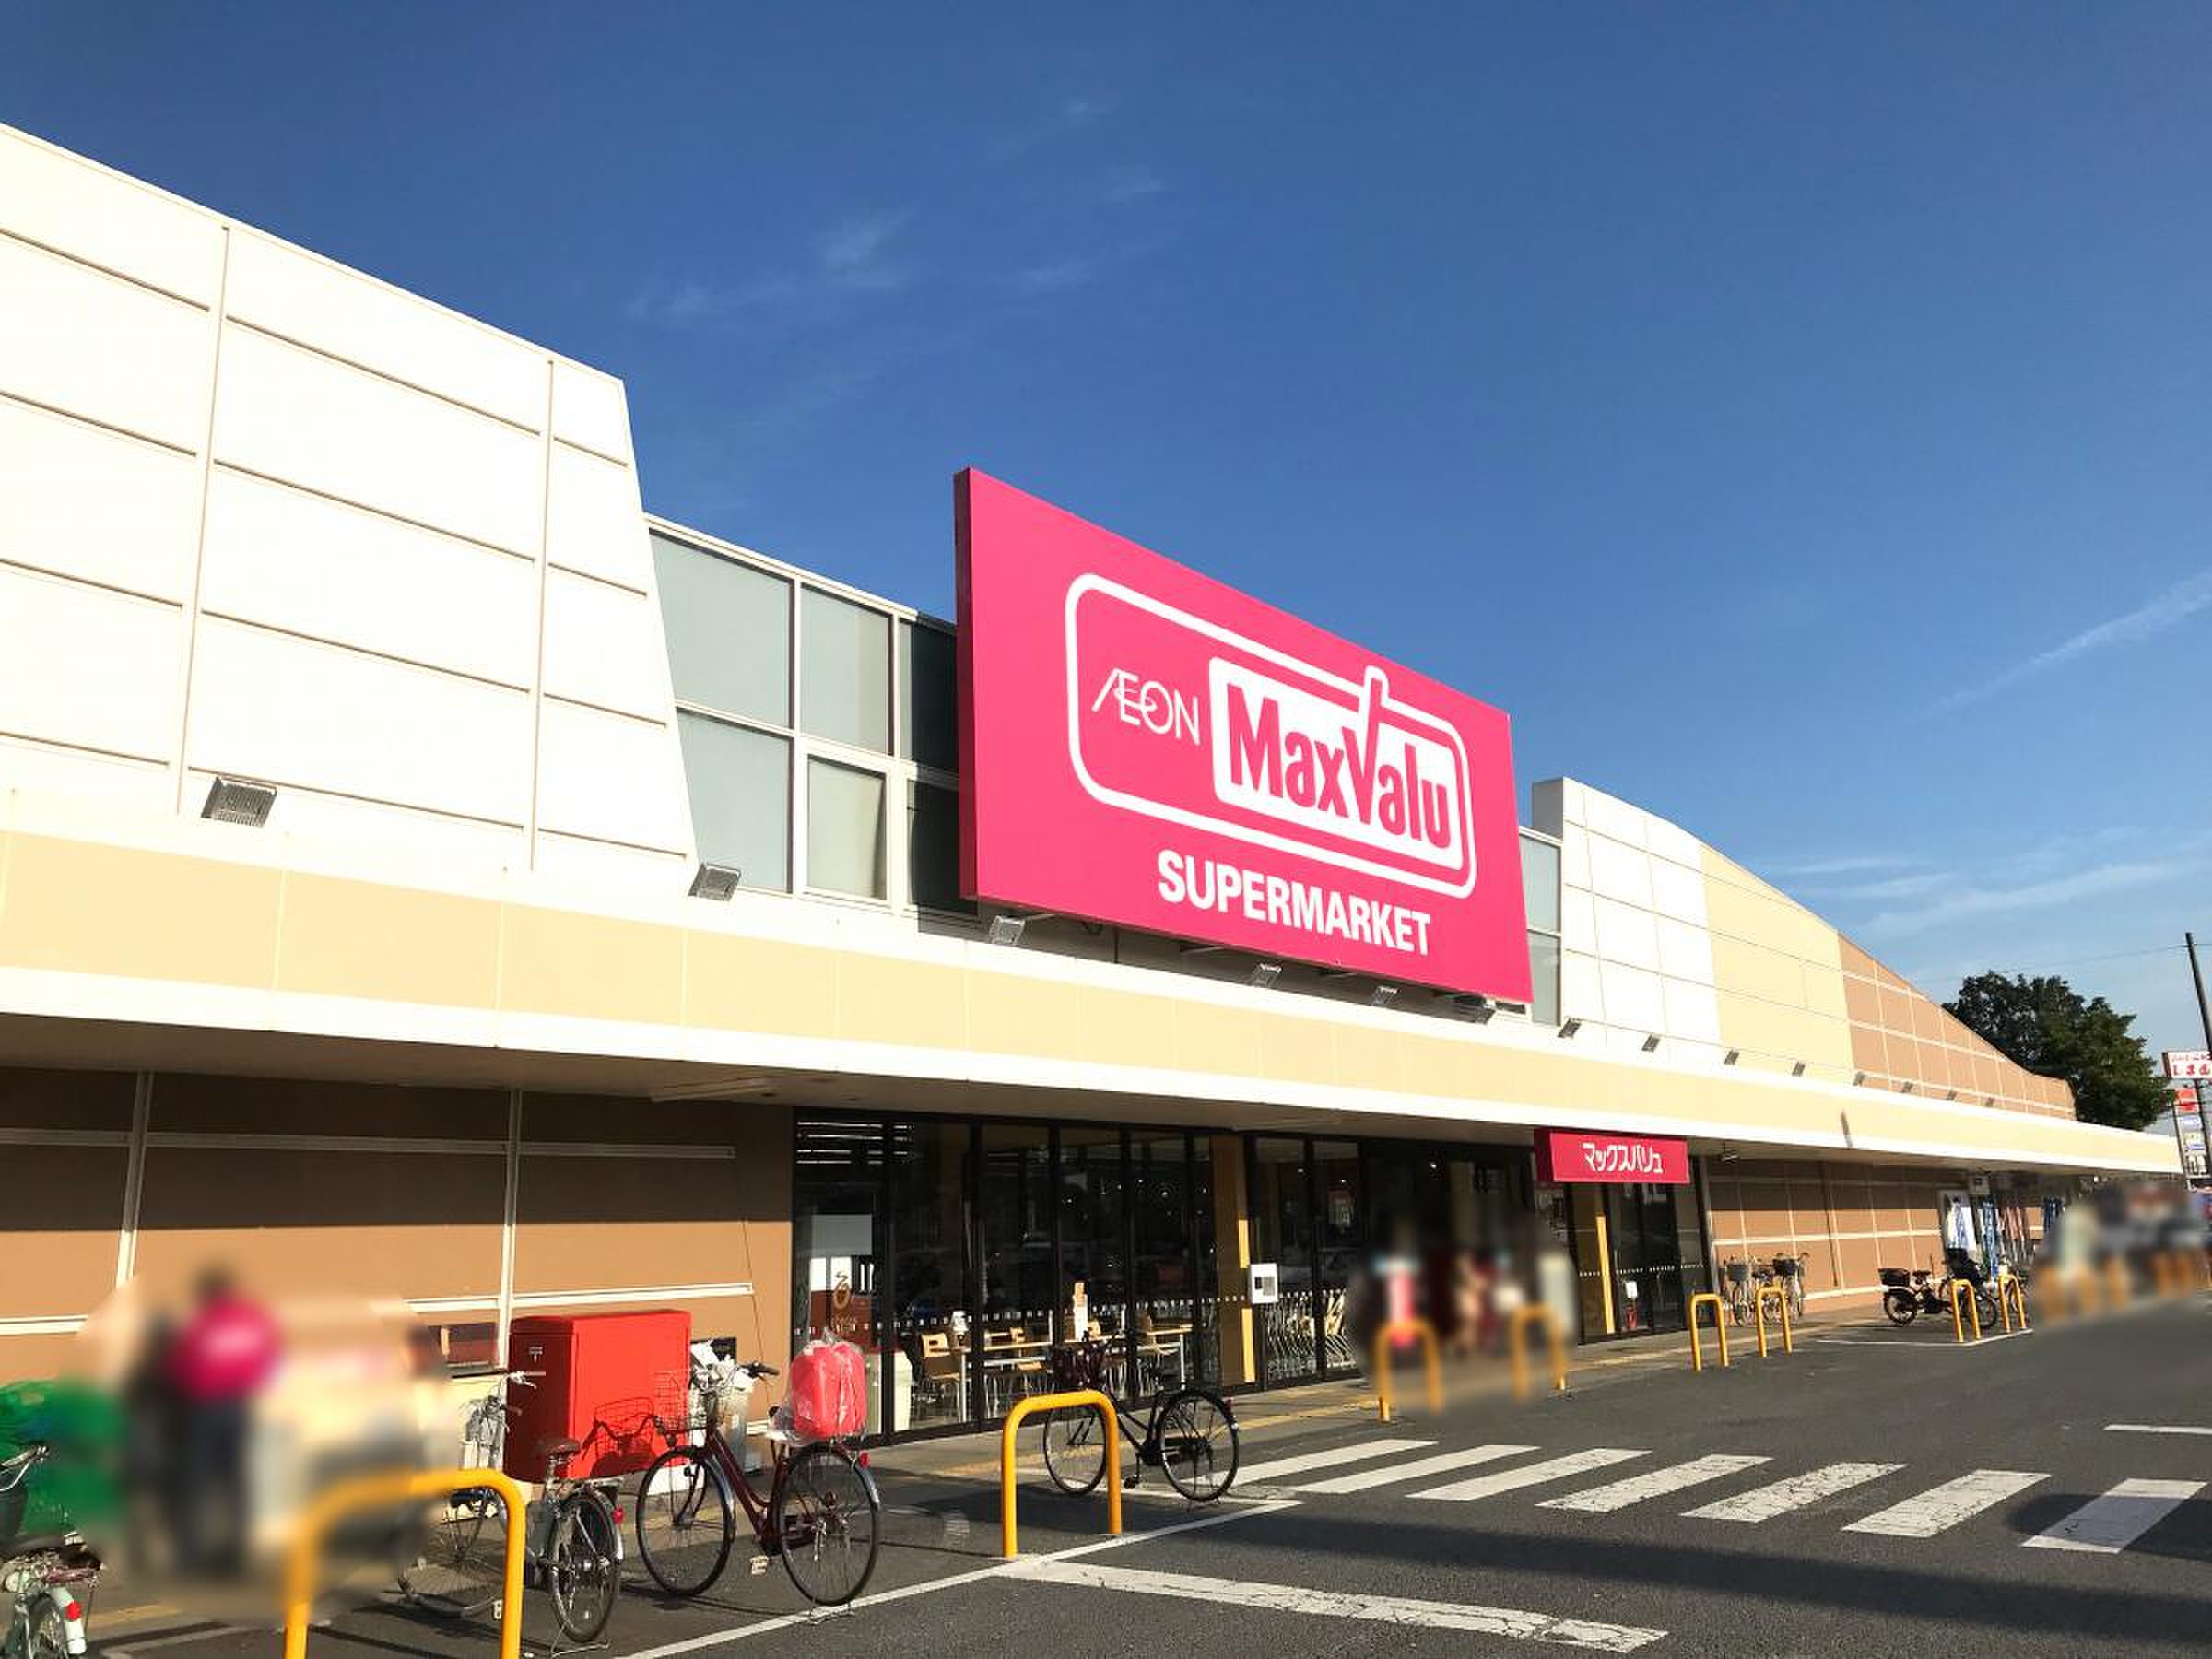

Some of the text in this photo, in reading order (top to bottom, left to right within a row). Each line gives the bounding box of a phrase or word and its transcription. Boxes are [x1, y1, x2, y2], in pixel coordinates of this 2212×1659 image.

[1227, 677, 1451, 849] MaxValu
[1157, 850, 1431, 956] SUPERMARKET
[1583, 1142, 1664, 1173] マックスバリュ
